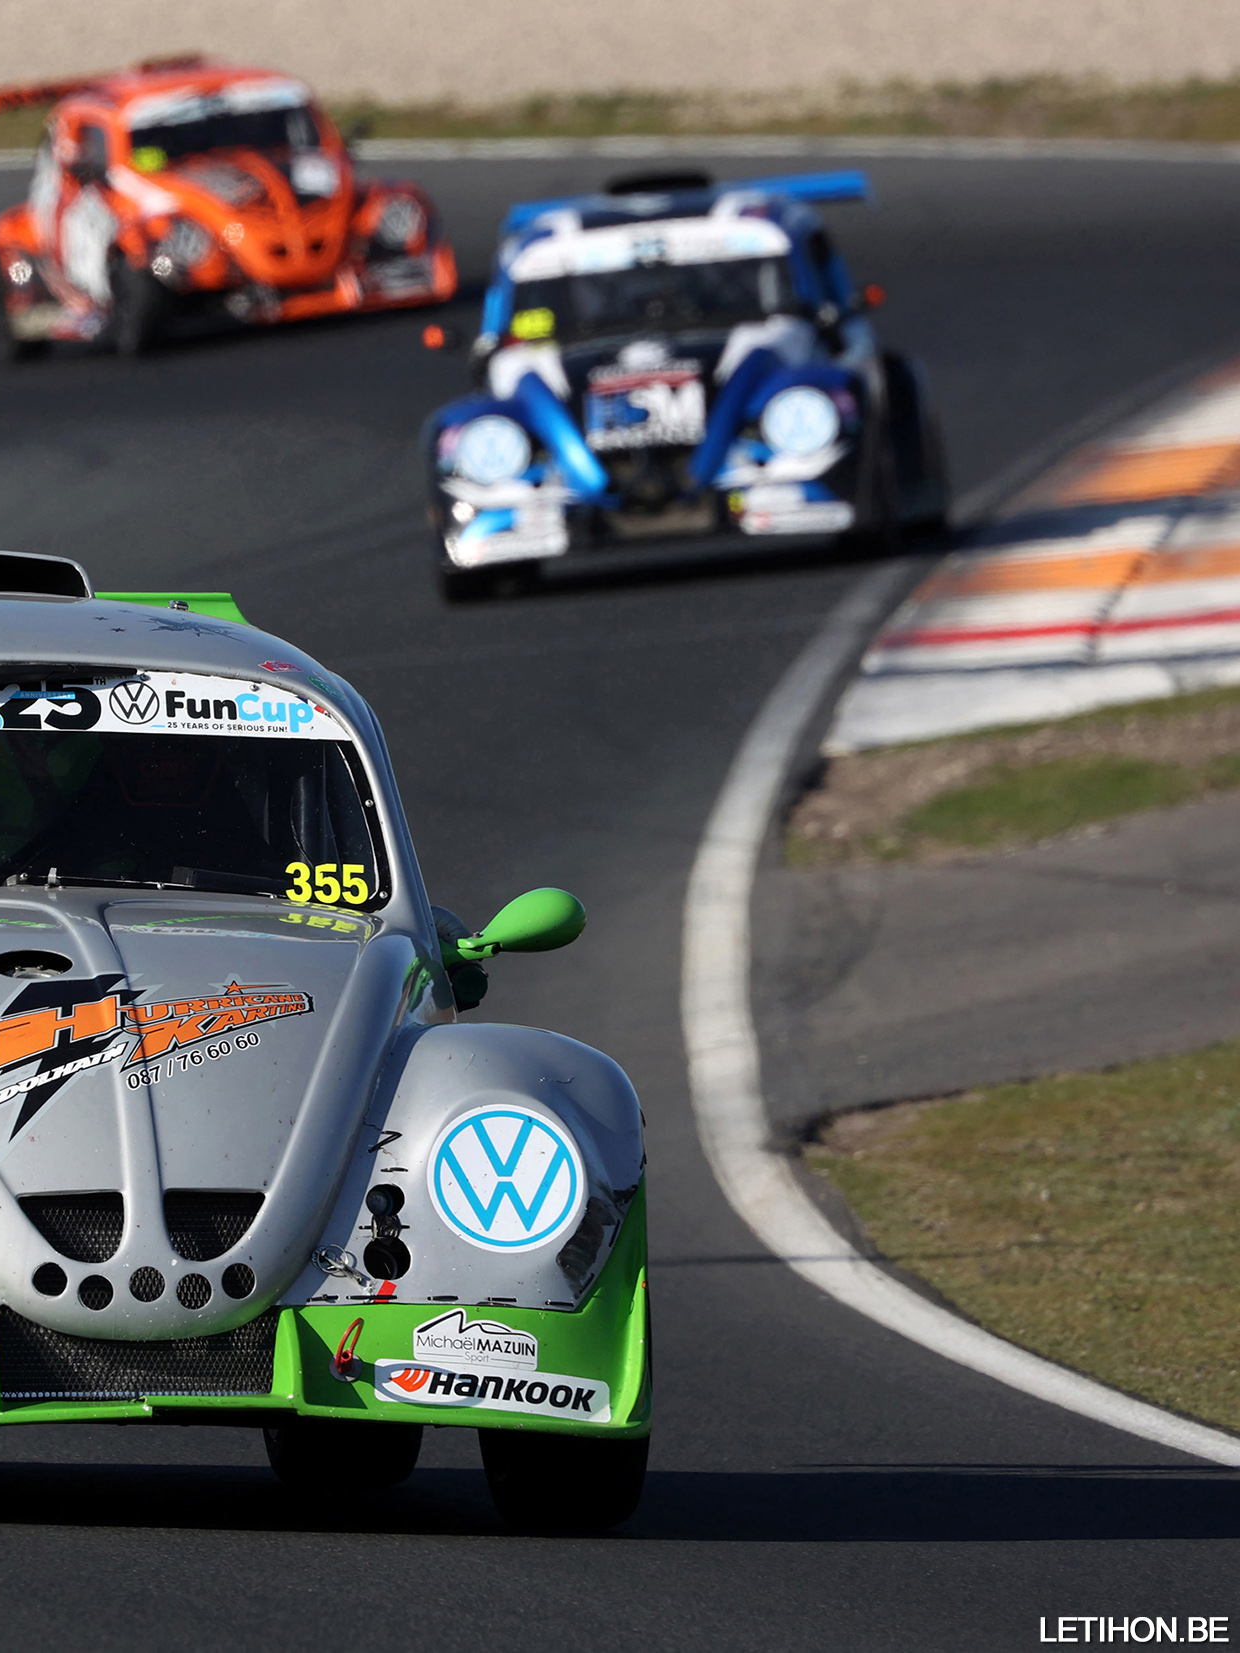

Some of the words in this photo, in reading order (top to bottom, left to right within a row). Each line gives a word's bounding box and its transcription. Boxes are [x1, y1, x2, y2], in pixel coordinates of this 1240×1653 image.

[165, 690, 314, 733] FunCup
[181, 722, 209, 730] YEARS
[227, 724, 265, 732] SERIOUS
[268, 725, 288, 733] FUN!
[284, 861, 369, 904] 355
[124, 1003, 306, 1064] KARTING
[127, 1065, 161, 1090] 087
[176, 1050, 203, 1071] 76
[206, 1040, 231, 1059] 60
[235, 1032, 260, 1050] 60
[464, 1352, 490, 1363] Sport
